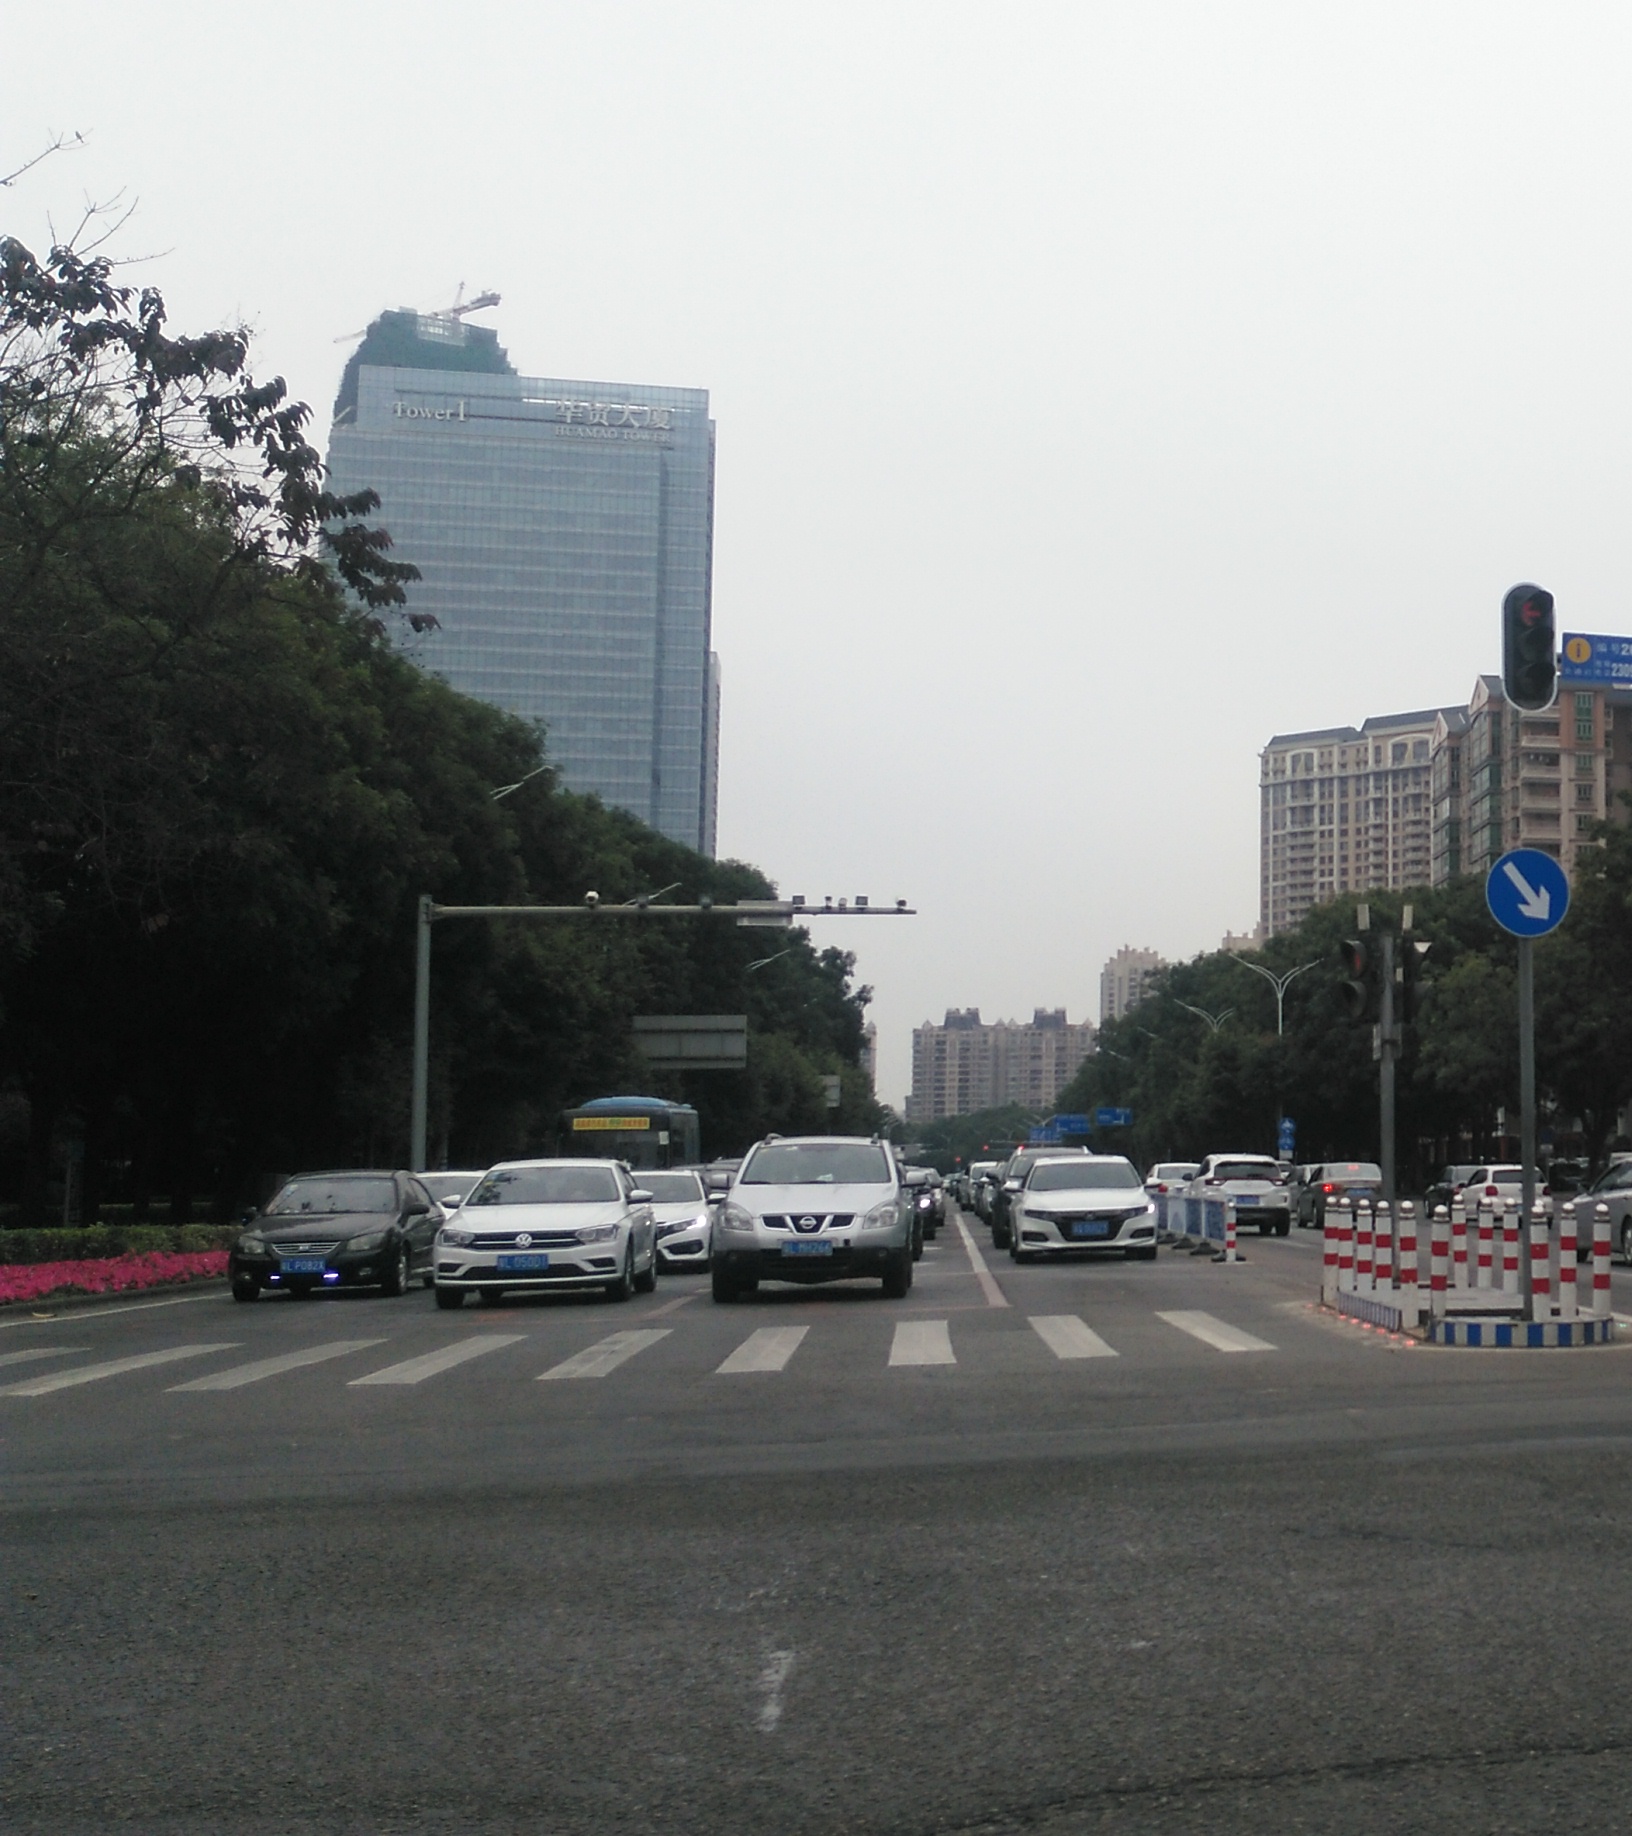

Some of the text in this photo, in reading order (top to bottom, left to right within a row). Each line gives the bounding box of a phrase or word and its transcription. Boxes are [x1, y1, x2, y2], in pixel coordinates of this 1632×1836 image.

[556, 400, 671, 430] 华贸大厦
[555, 426, 671, 443] HUAMAO TOWER
